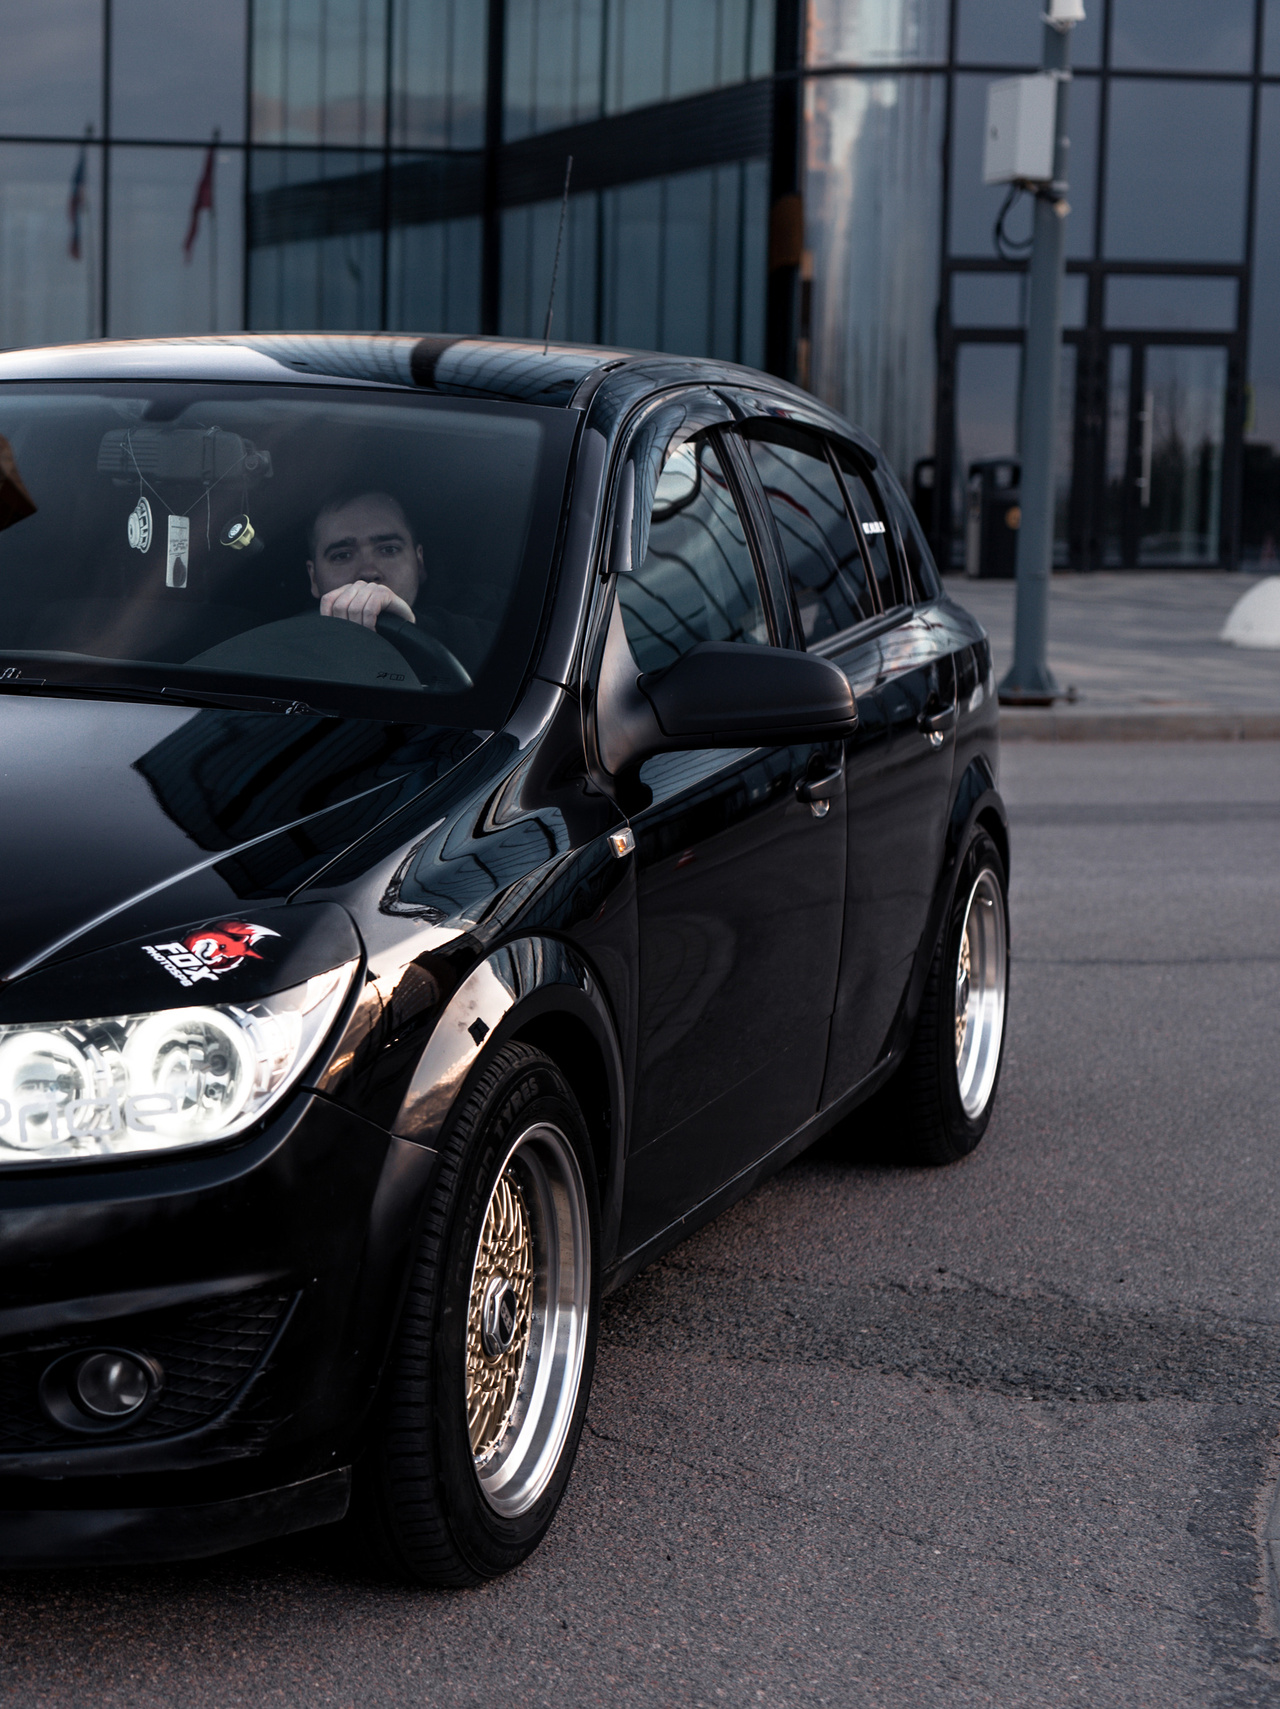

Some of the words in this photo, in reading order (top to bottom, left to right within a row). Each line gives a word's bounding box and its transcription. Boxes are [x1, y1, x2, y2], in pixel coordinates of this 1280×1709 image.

[141, 945, 194, 987] PHOTOSPB
[154, 942, 219, 982] FOX
[493, 1077, 540, 1141] TYRES
